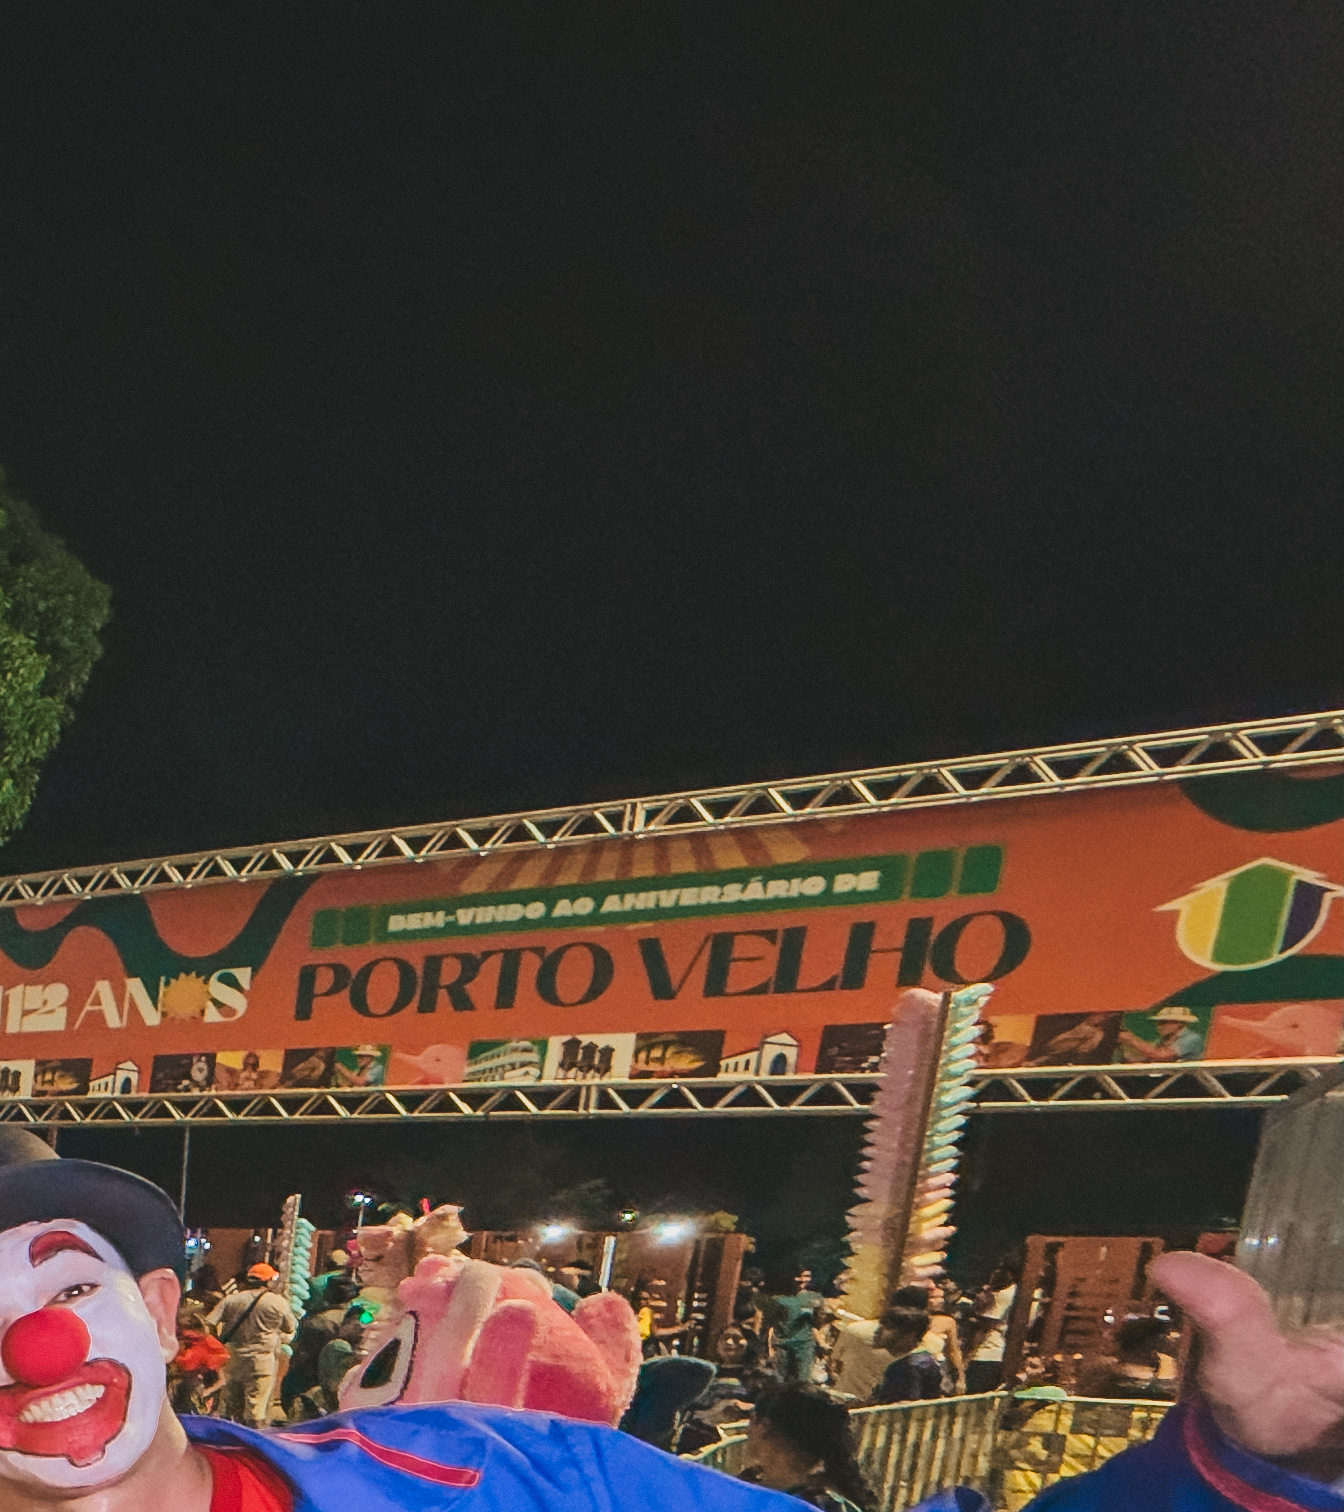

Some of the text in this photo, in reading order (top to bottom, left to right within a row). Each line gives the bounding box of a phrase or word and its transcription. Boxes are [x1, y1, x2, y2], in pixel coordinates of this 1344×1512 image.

[386, 869, 883, 933] BEM-VINDO AO ANIVERSÁRIO DE
[293, 909, 1033, 1022] PORTO VELHO
